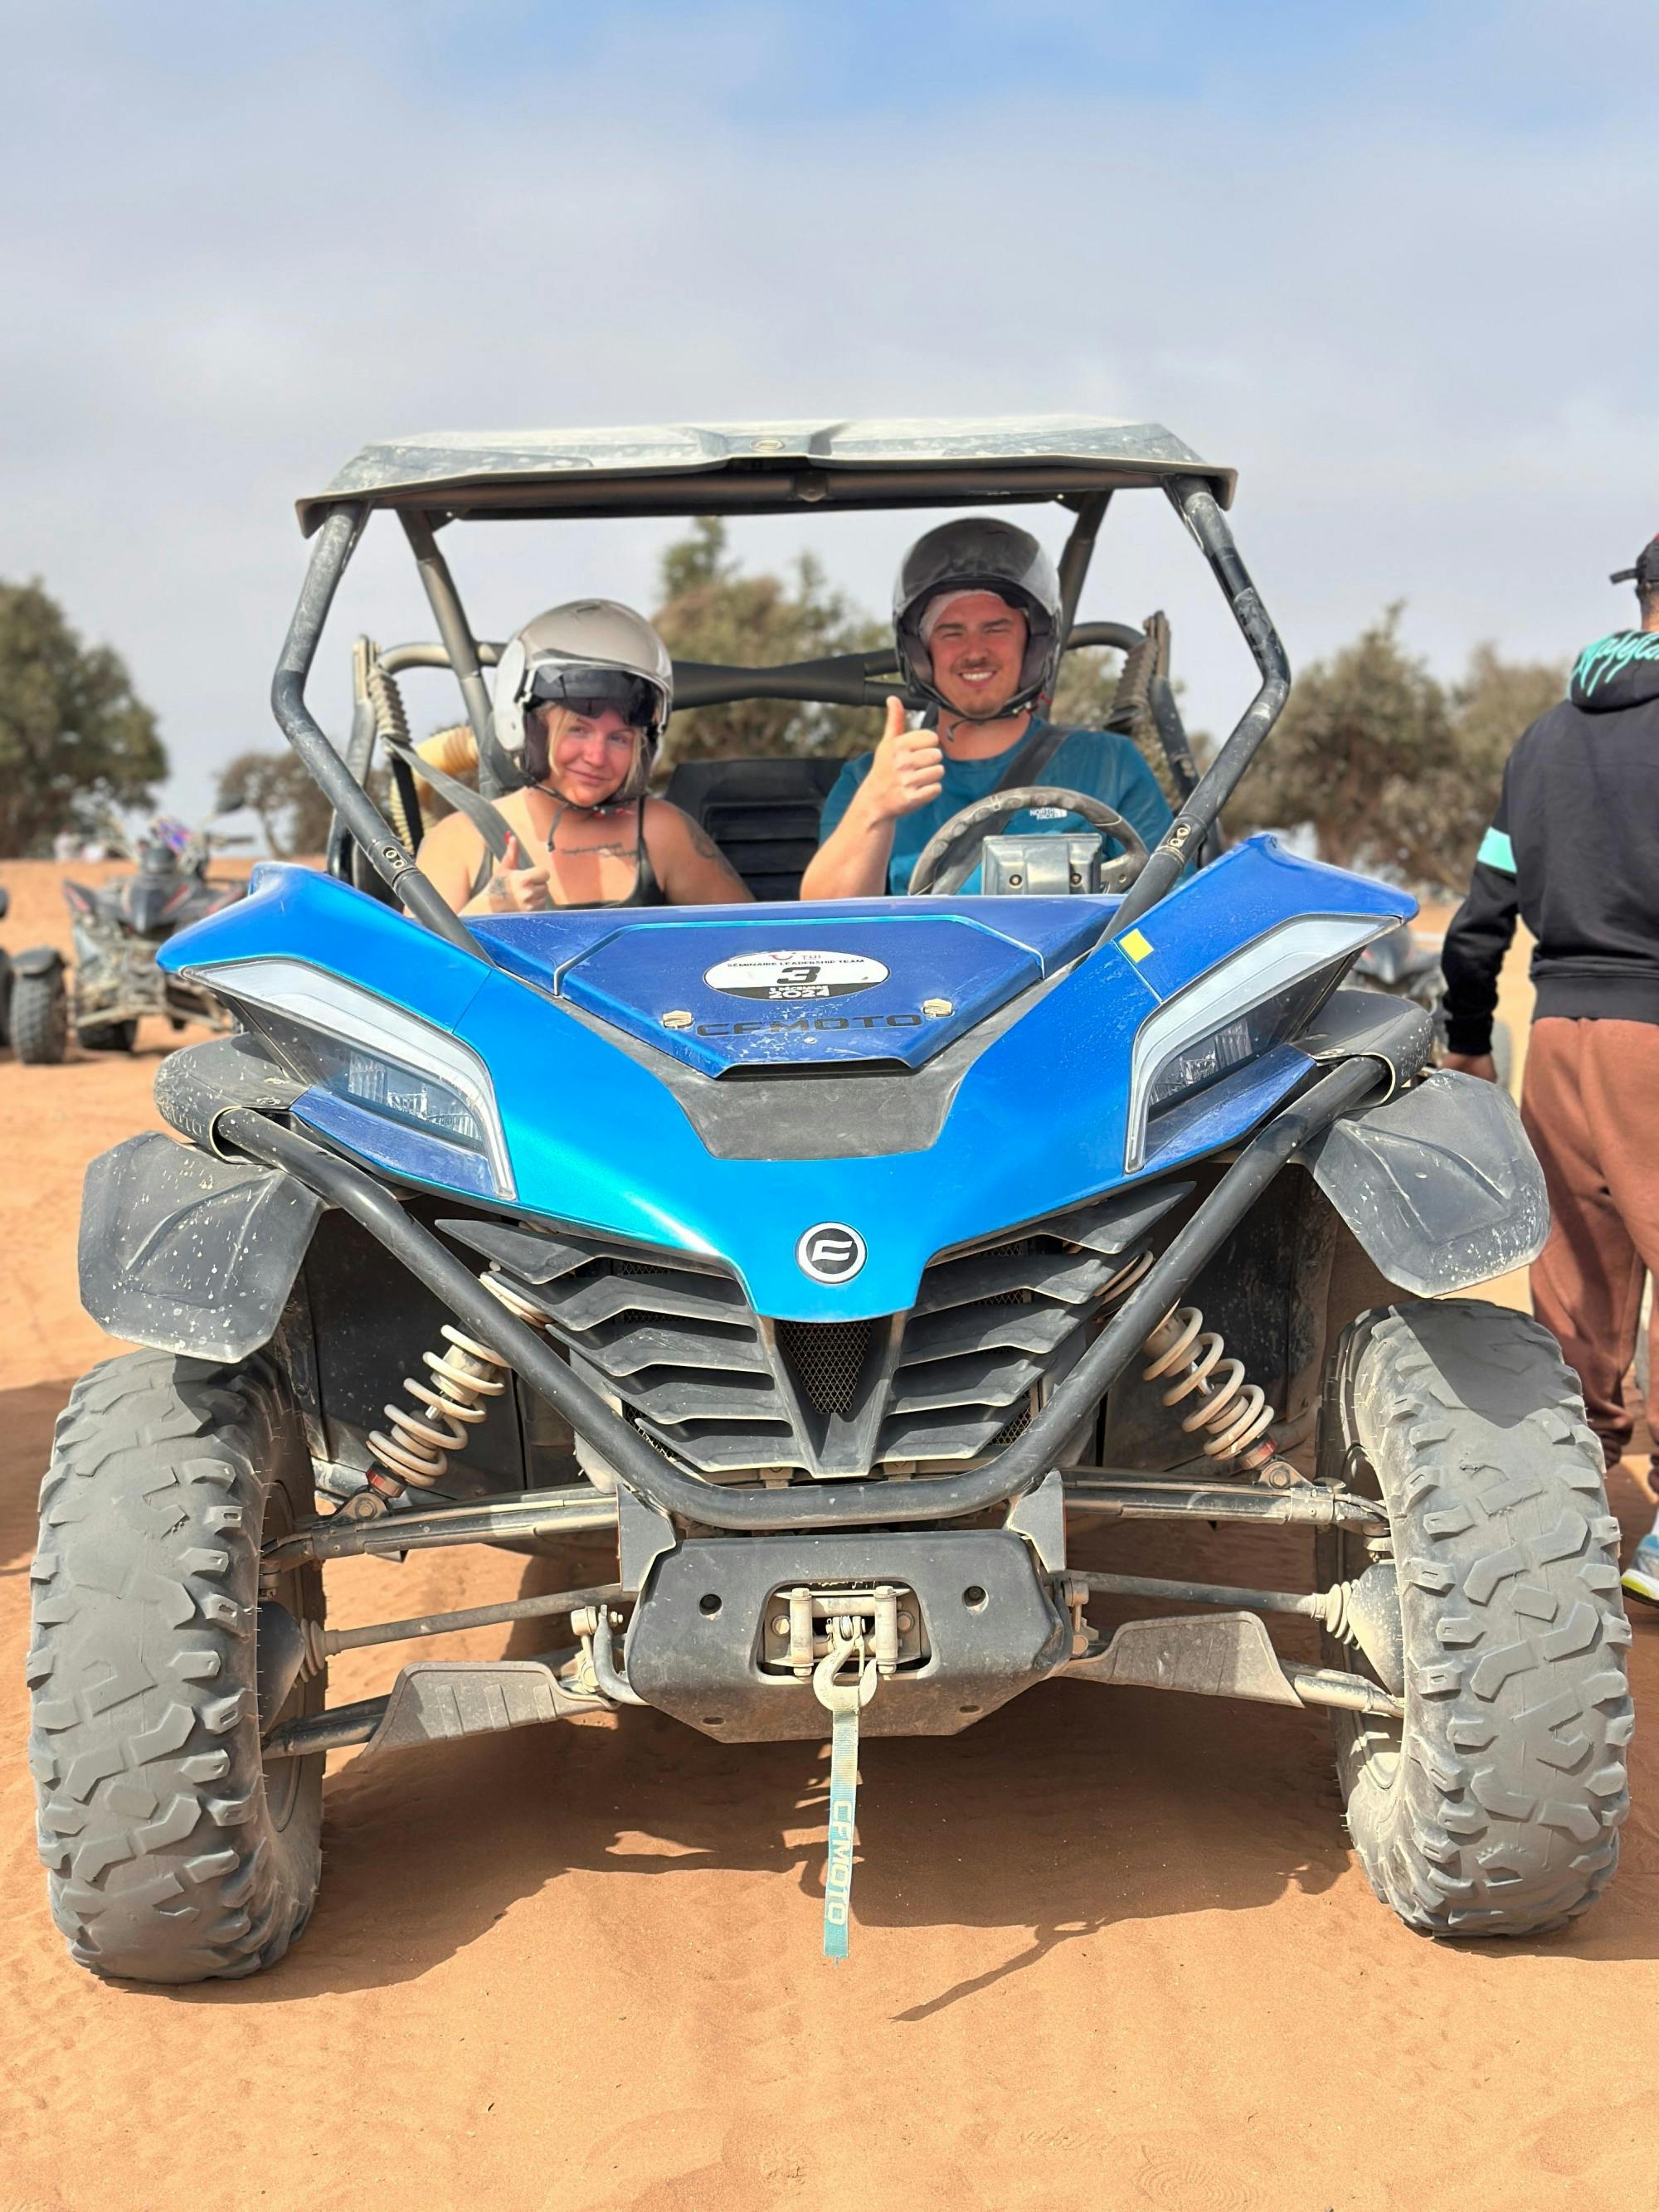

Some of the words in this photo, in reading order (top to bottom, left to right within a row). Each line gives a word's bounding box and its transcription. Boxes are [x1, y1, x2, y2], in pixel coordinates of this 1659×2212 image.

[1029, 807, 1054, 816] NORTH
[776, 966, 821, 984] 3
[768, 989, 830, 999] 2024
[696, 1014, 923, 1037] CFMOTO
[827, 1800, 854, 1925] CFMOTO
